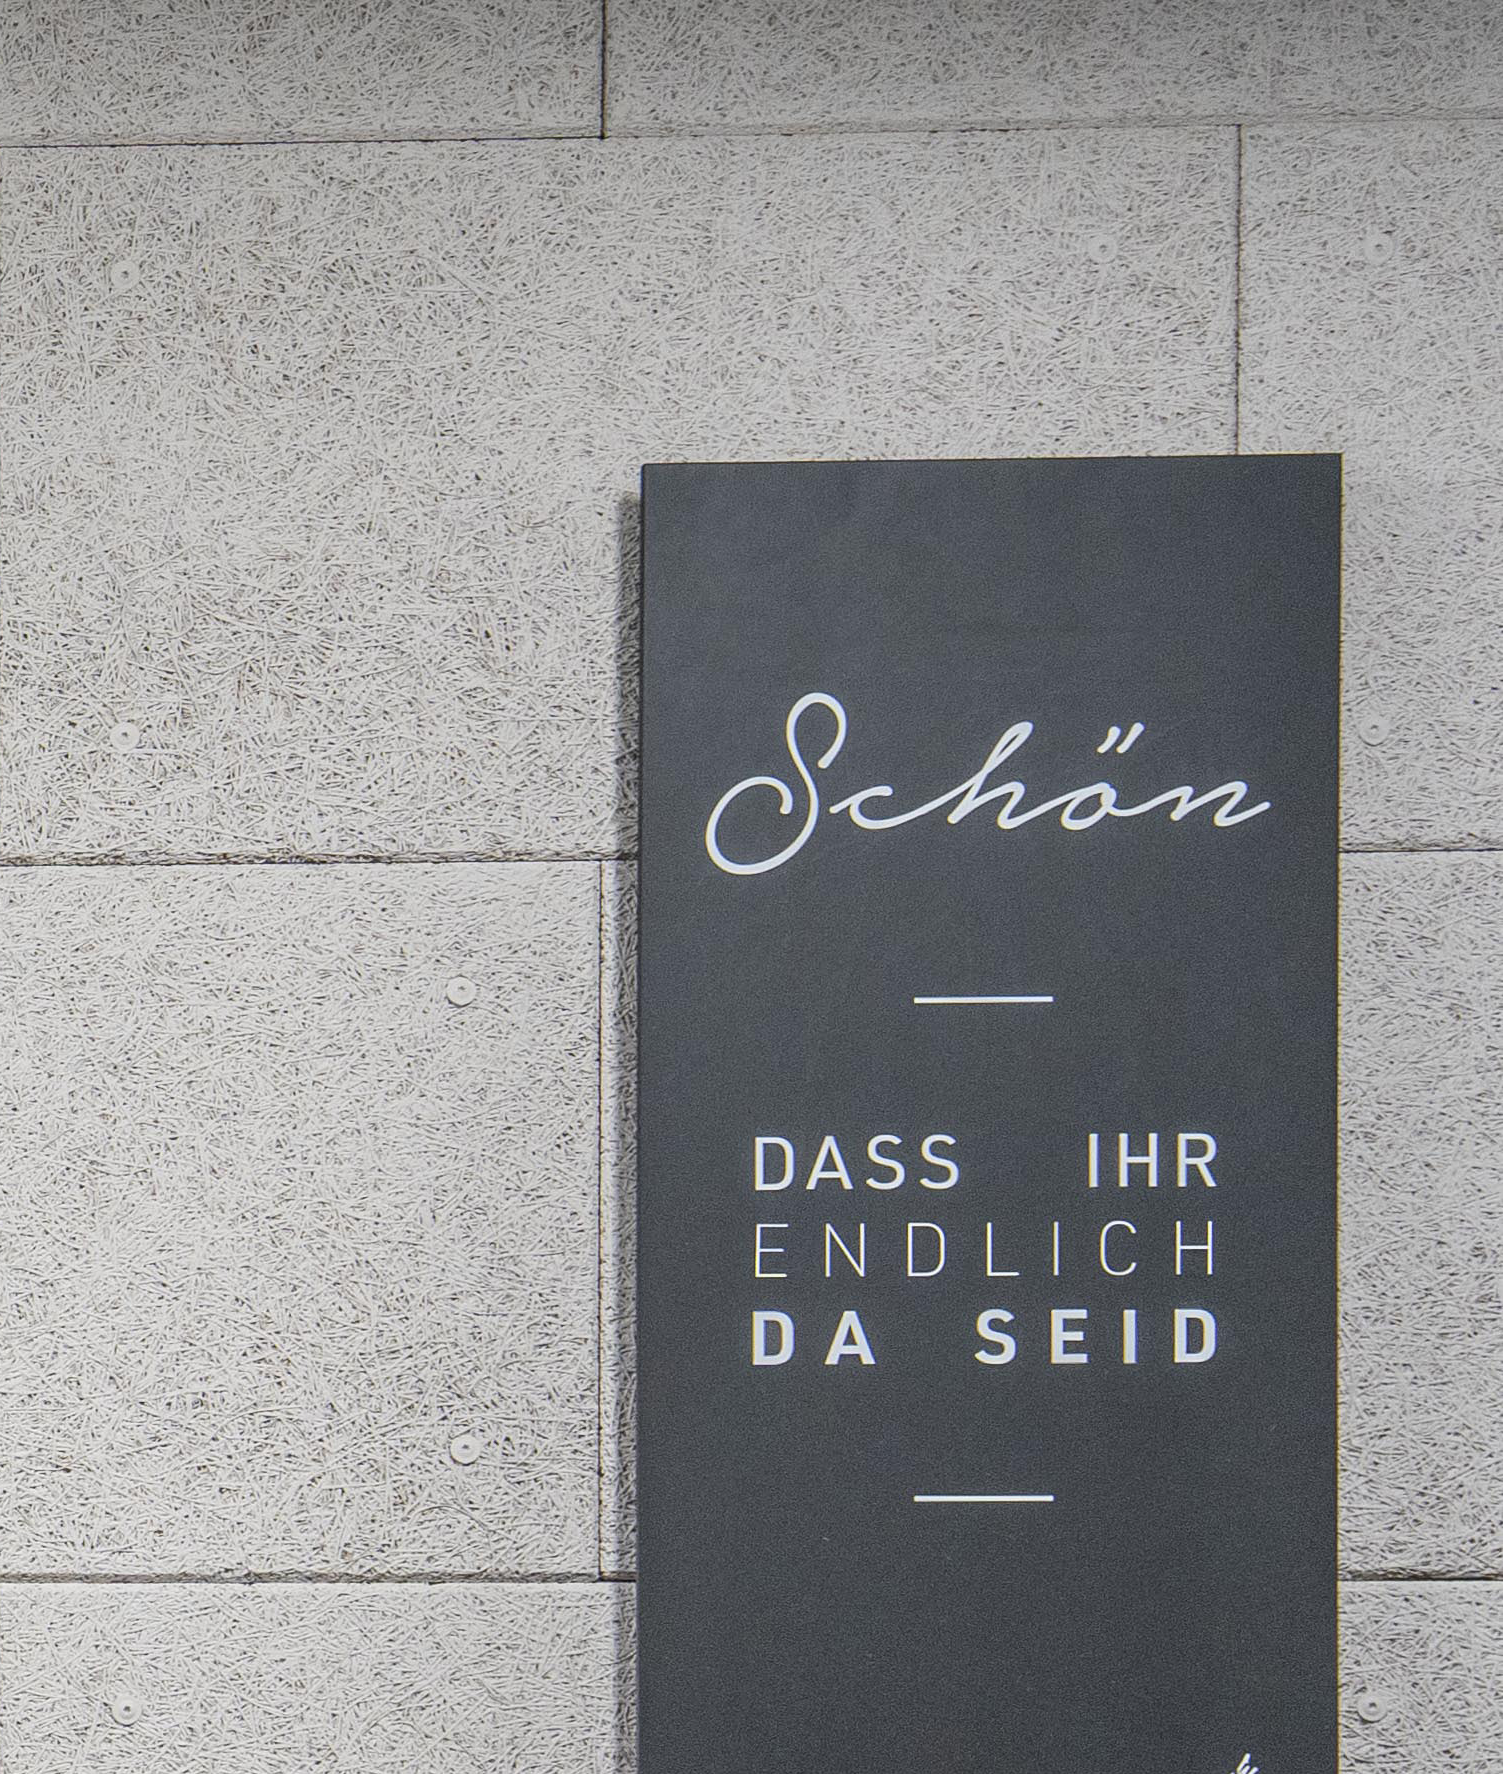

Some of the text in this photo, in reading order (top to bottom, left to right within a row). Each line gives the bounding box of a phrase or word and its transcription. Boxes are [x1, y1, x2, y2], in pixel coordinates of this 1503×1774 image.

[705, 692, 1271, 875] Schön
[754, 1132, 1217, 1191] DASS IHR
[754, 1220, 1215, 1278] ENDLICH
[752, 1308, 1218, 1366] DA SEID
